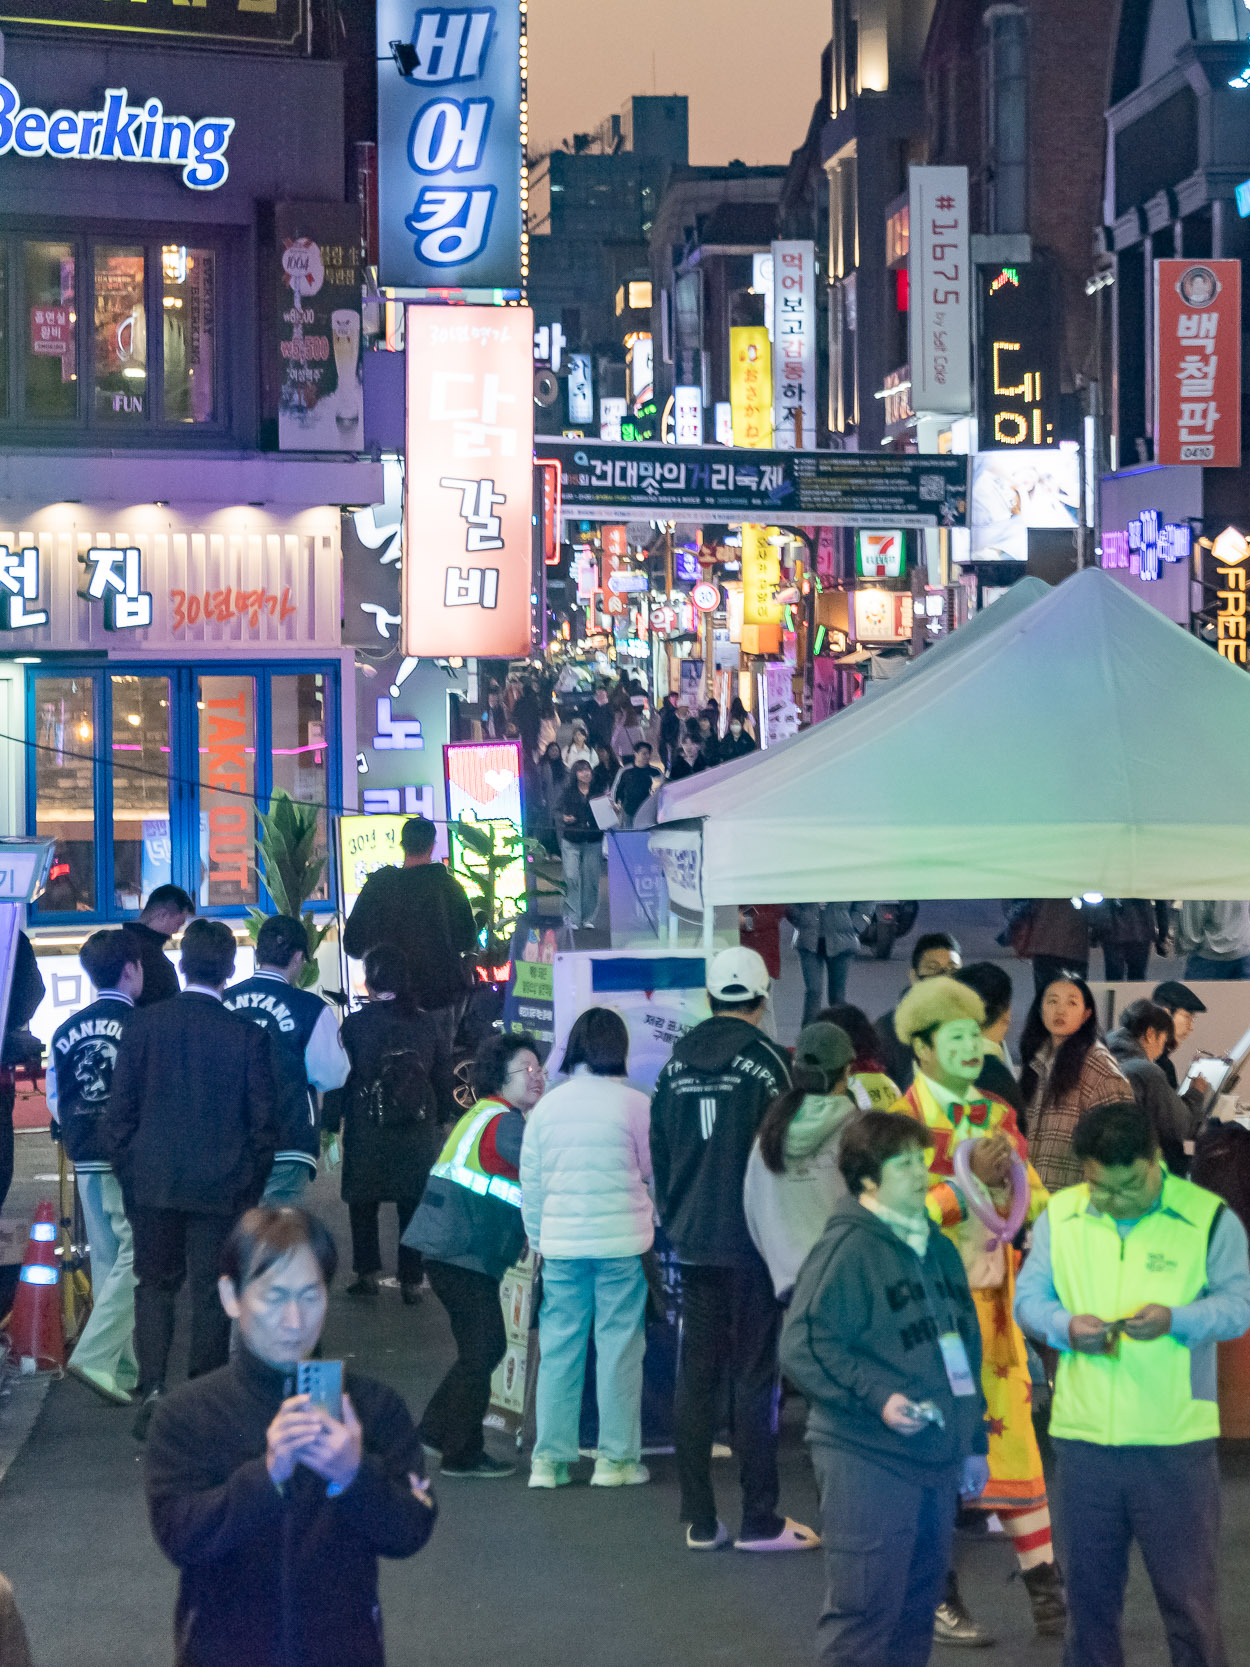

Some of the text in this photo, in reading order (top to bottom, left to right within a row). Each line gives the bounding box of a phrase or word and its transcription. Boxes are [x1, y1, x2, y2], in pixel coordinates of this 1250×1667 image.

[407, 7, 497, 268] 비어킹
[932, 196, 960, 304] #1675
[1176, 312, 1220, 443] 백철판
[428, 370, 518, 609] 닭갈비
[590, 459, 785, 494] 건대맛의거리축제
[171, 585, 296, 632] 30년명가
[1217, 566, 1246, 663] FREE
[208, 692, 249, 890] TAKE OUT
[667, 1060, 688, 1077] TH
